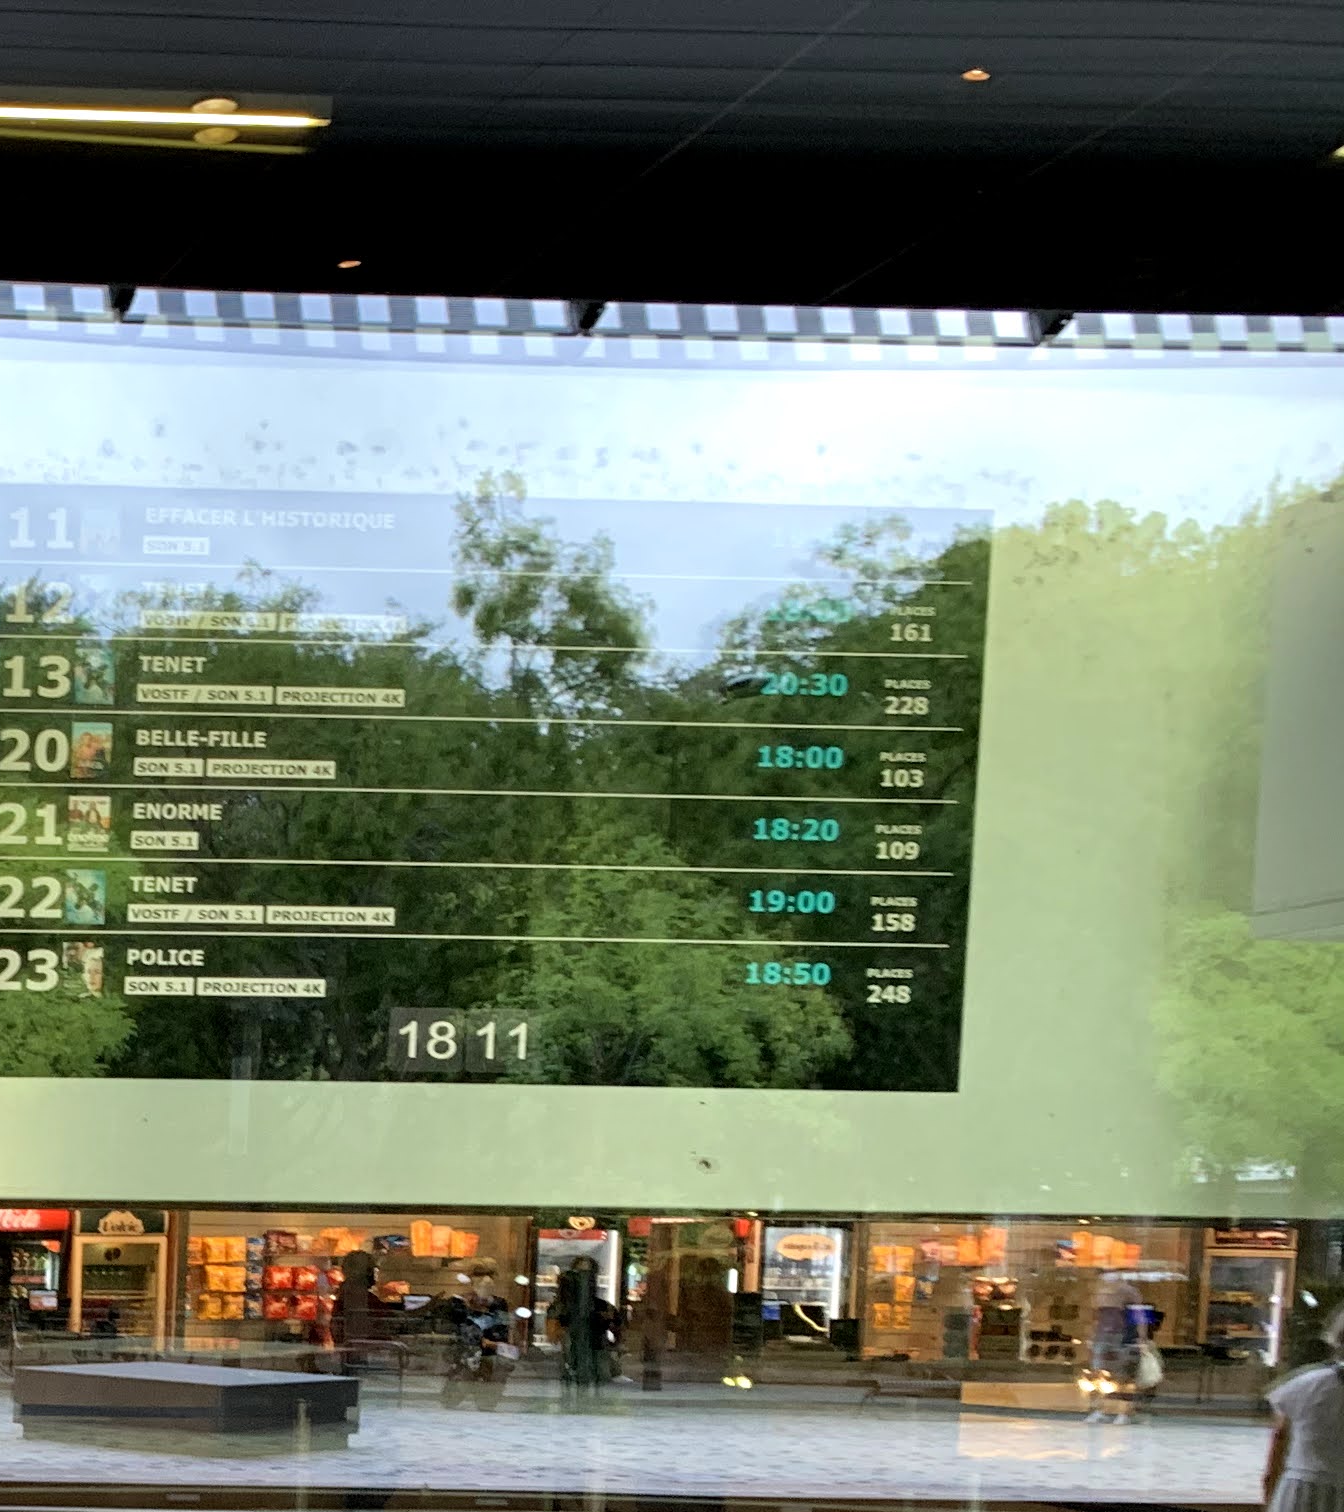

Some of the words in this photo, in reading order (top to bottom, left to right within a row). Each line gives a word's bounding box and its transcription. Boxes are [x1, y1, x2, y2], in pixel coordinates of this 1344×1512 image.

[146, 508, 236, 526] EFFACER
[9, 507, 75, 550] 11
[890, 624, 932, 642] 161
[140, 655, 207, 673] TENET
[4, 655, 72, 698] 13
[760, 673, 849, 697] 20:30
[141, 687, 190, 700] VOSTF
[207, 690, 239, 701] SON
[244, 690, 267, 702] 5.1
[282, 691, 378, 704] PROJECTION
[382, 693, 401, 704] 4K
[885, 697, 928, 715] 228
[136, 731, 267, 748] BELLE-FILLE
[757, 746, 844, 770] 18:00
[138, 761, 169, 773] SON
[175, 762, 197, 774] 5.1
[212, 764, 308, 776] PROJECTION
[313, 765, 332, 776] 4K
[880, 769, 924, 787] 103
[133, 803, 222, 821] ENORME
[753, 818, 839, 842] 18:20
[876, 842, 920, 860] 109
[130, 877, 197, 893] TENET
[748, 891, 835, 914] 19:00
[871, 914, 916, 932] 158
[127, 949, 204, 967] POLICE
[744, 963, 831, 986] 18:50
[866, 985, 910, 1003] 248
[399, 1022, 457, 1060] 18
[476, 1023, 528, 1060] 11
